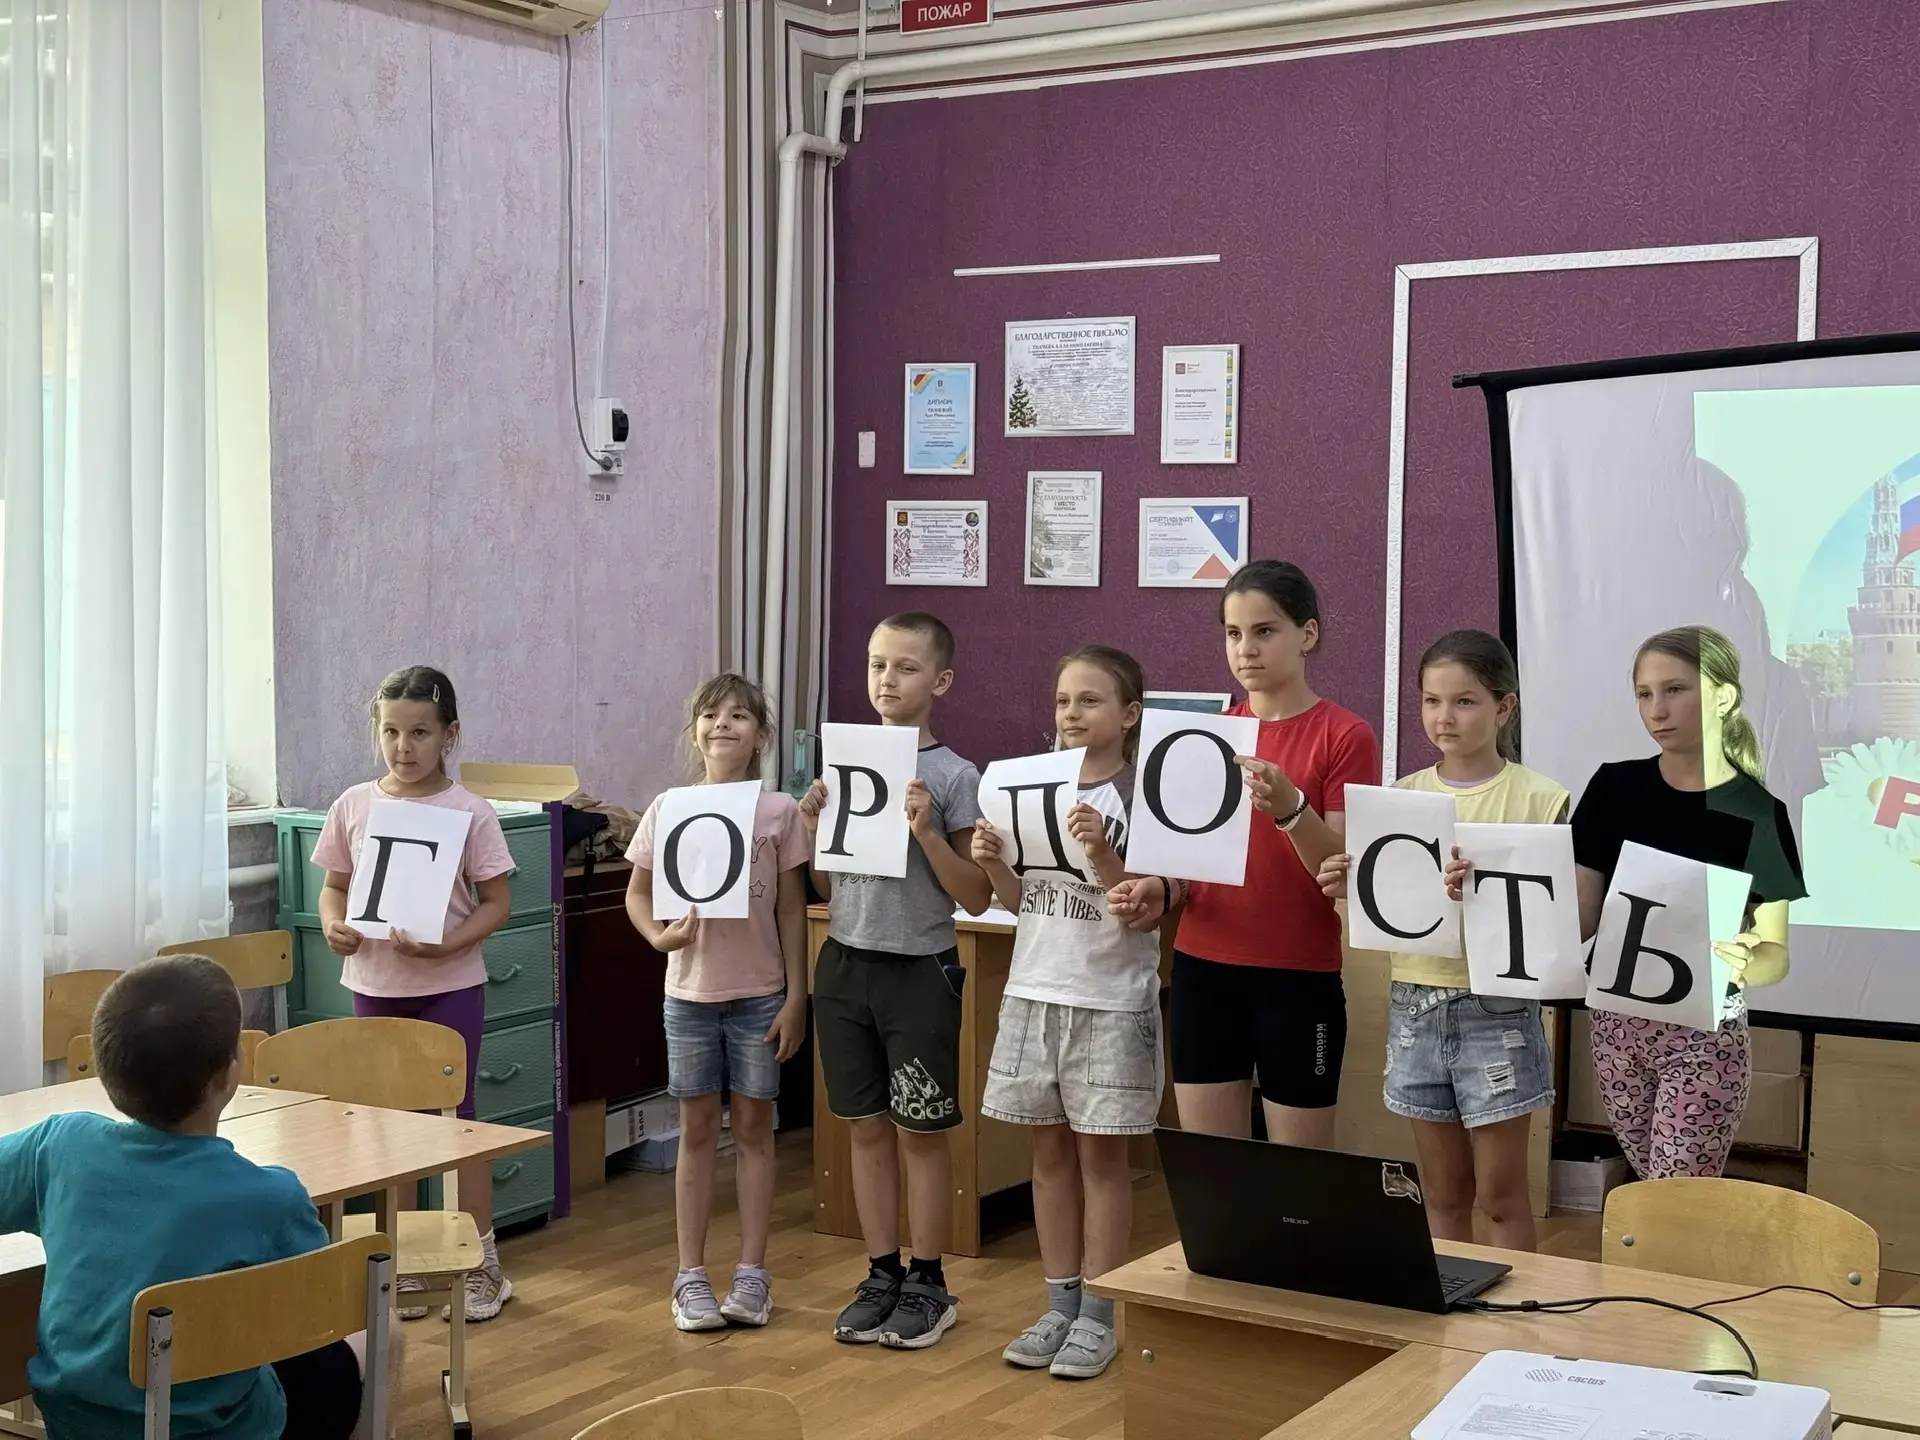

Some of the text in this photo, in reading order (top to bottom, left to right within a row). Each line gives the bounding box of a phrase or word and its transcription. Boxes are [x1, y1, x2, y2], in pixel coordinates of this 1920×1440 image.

[917, 2, 972, 22] ПОЖАР
[1093, 328, 1128, 337] ПИСЬМО
[820, 764, 889, 857] Р
[1143, 728, 1243, 835] О
[663, 812, 745, 904] О
[998, 781, 1088, 883] Д
[351, 835, 439, 923] Г
[1063, 889, 1103, 922] VIBES
[1356, 833, 1444, 939] С
[1474, 869, 1555, 982] Т
[1596, 891, 1694, 1005] Ь
[1567, 1374, 1606, 1386] cactus
